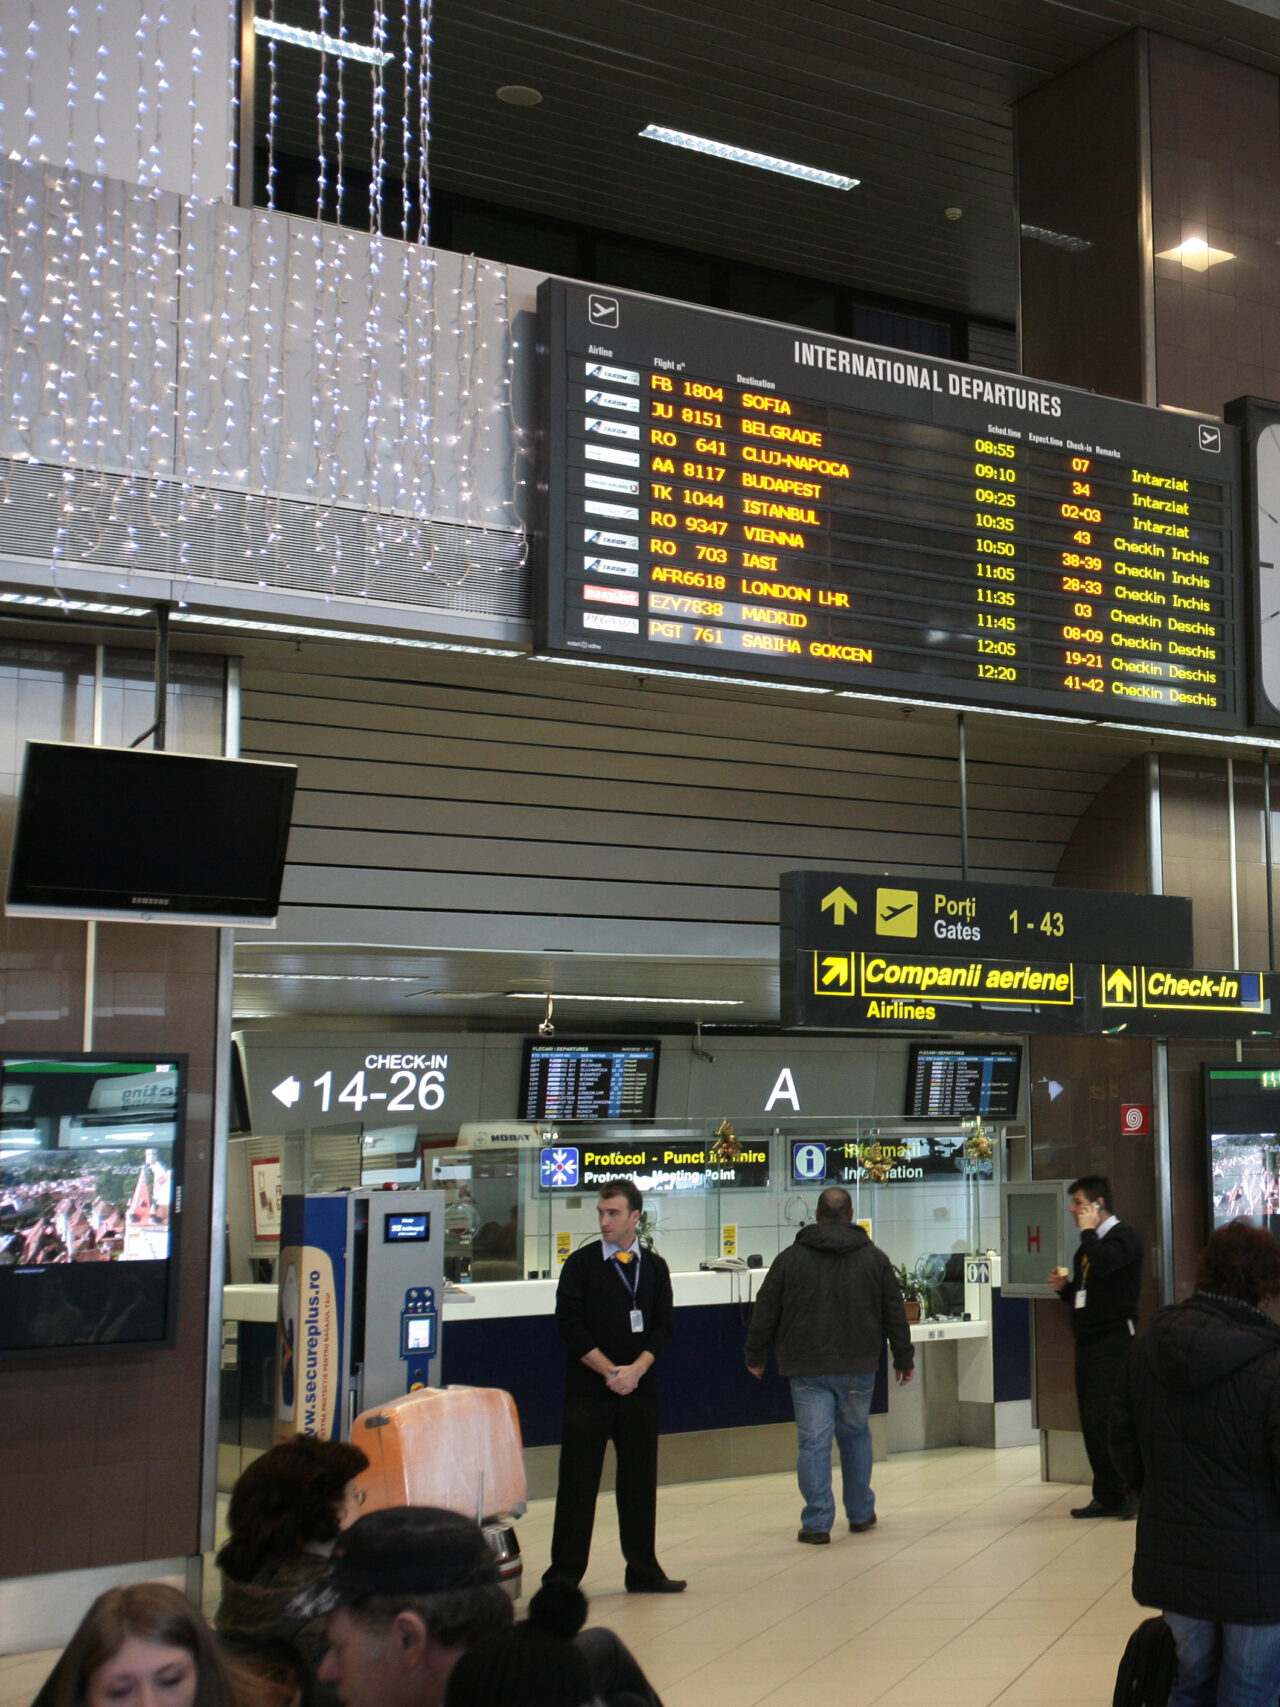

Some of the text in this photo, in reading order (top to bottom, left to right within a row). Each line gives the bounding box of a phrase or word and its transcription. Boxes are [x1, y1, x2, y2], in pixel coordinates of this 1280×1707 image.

[589, 345, 775, 389] Airline Flight Destination
[794, 341, 1062, 417] INTERNATIONAL DEPARTURES
[651, 375, 1188, 492] FB 1804 SOFIA 08:55 07 Intarziat
[652, 402, 1189, 516] JU 8151 BELGRADE 09:10 34 Intarziat
[651, 430, 1189, 539] RO 641 CLUJ-NAPOCA 09:25 02-03 Intarziat
[653, 458, 1209, 565] AA 8117 BUDAPEST 10:35 43 Checkin Inchis
[653, 485, 1210, 589] TK 1044 ISTANBUL 10:50 38-39 Checkin Inchis
[651, 512, 1210, 612] RO 9347 VIENNA 11:05 28-33 Checkin Inchis
[651, 540, 1215, 637] RO 703 IASI 11:35 03 Checkin Deschis
[652, 568, 1216, 660] AFR6618 LONDON LHR 11:45 08-09 Deschis
[693, 627, 1216, 707] 761 SABIHA 12:20 41-42 Deschis
[742, 607, 1216, 684] MADRID 12:05 19-21 Deschis
[132, 897, 170, 906] SAMSUNG
[935, 894, 976, 923] Porți
[1009, 910, 1018, 934] 1
[1041, 912, 1065, 937] 43
[934, 919, 980, 942] Gates
[866, 958, 1068, 992] Companii aeriene
[1148, 972, 1238, 1000] Check-in
[867, 1001, 936, 1021] Airlines
[365, 1054, 448, 1069] CHECK-IN
[313, 1070, 446, 1112] 14-26
[764, 1068, 800, 1111] A
[585, 1152, 645, 1165] Protocol
[664, 1152, 705, 1163] Punct
[705, 1169, 735, 1180] Point
[1027, 1225, 1041, 1253] H
